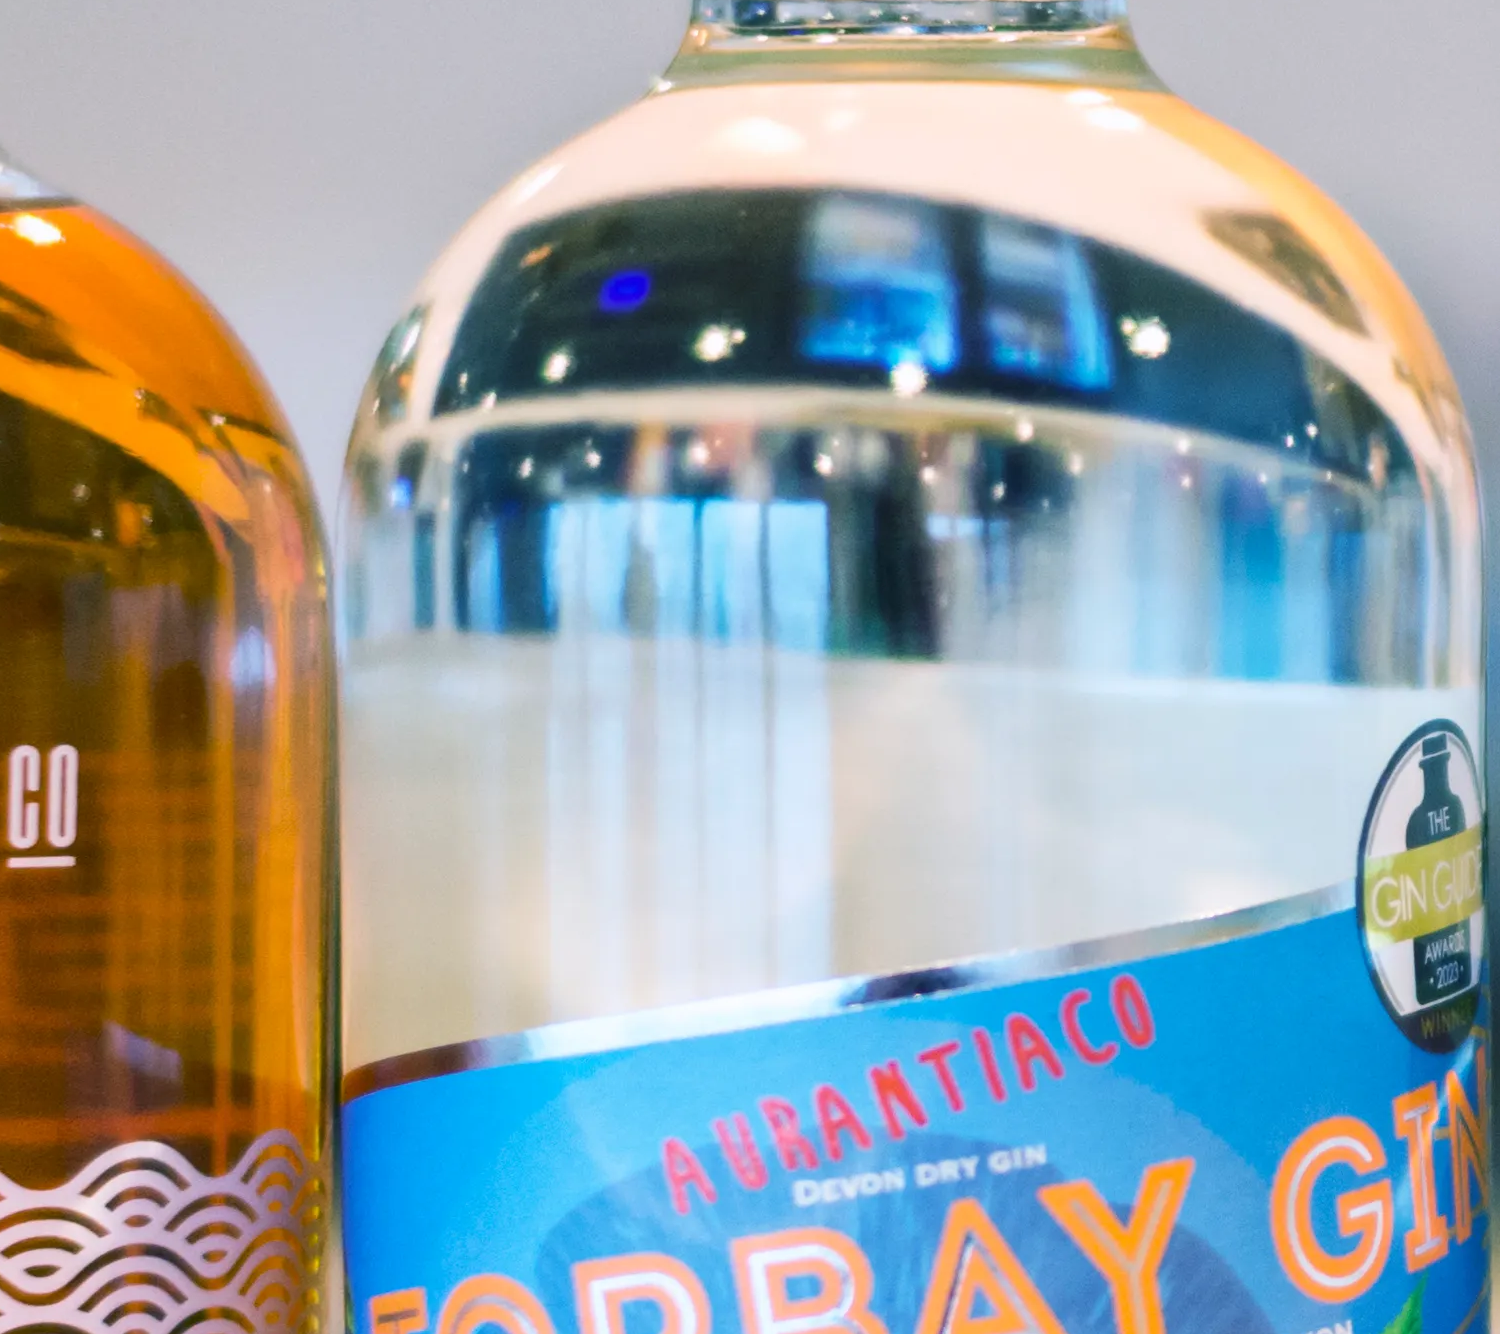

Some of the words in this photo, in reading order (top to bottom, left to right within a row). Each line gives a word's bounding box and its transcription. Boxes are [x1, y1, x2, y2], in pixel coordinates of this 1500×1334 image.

[8, 744, 80, 850] CO
[1428, 807, 1450, 835] THE
[1371, 869, 1427, 928] GIN
[1424, 930, 1464, 965] AWARDS
[662, 974, 1156, 1215] AURANTIACO
[793, 1168, 906, 1207] DEVON
[915, 1156, 979, 1187] DRY
[988, 1144, 1047, 1174] GIN
[1270, 1045, 1488, 1303] GIN
